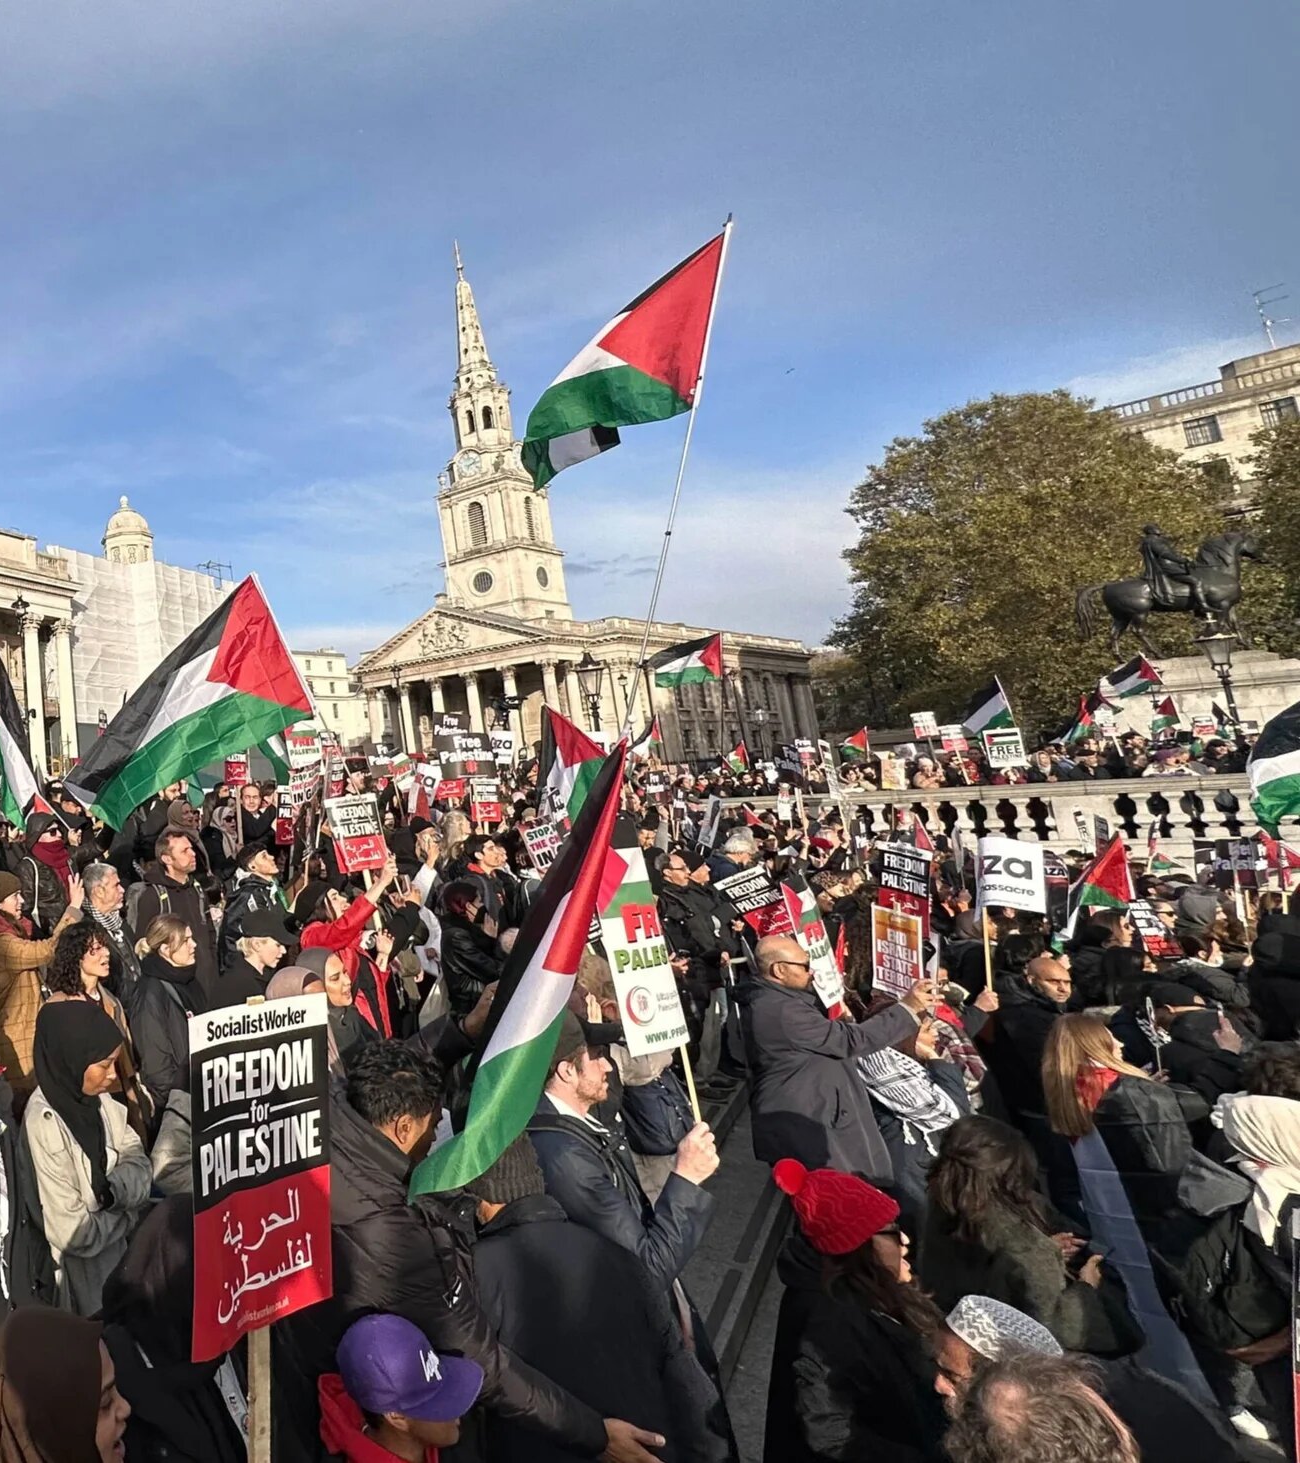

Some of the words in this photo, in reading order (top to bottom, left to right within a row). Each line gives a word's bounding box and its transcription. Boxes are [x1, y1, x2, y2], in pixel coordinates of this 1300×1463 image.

[453, 735, 482, 749] Free
[988, 744, 1022, 756] FREE
[293, 792, 304, 804] IN
[526, 825, 550, 841] STOP
[529, 840, 548, 852] THE
[536, 849, 555, 867] IN
[884, 852, 925, 876] FREEDOM
[980, 854, 1033, 880] za
[725, 875, 771, 900] FREEDOM
[881, 871, 927, 898] PALESTINE
[735, 888, 784, 913] PALESTINE
[620, 902, 662, 944] FR
[614, 944, 668, 974] PALES
[877, 938, 917, 964] ISRAELI
[882, 953, 914, 977] STATE
[201, 1037, 314, 1113] FREEDOM
[250, 1099, 271, 1124] for
[200, 1108, 322, 1197] PALESTINE
[222, 1186, 301, 1255] الحرية
[217, 1231, 313, 1325] لفلسطين
